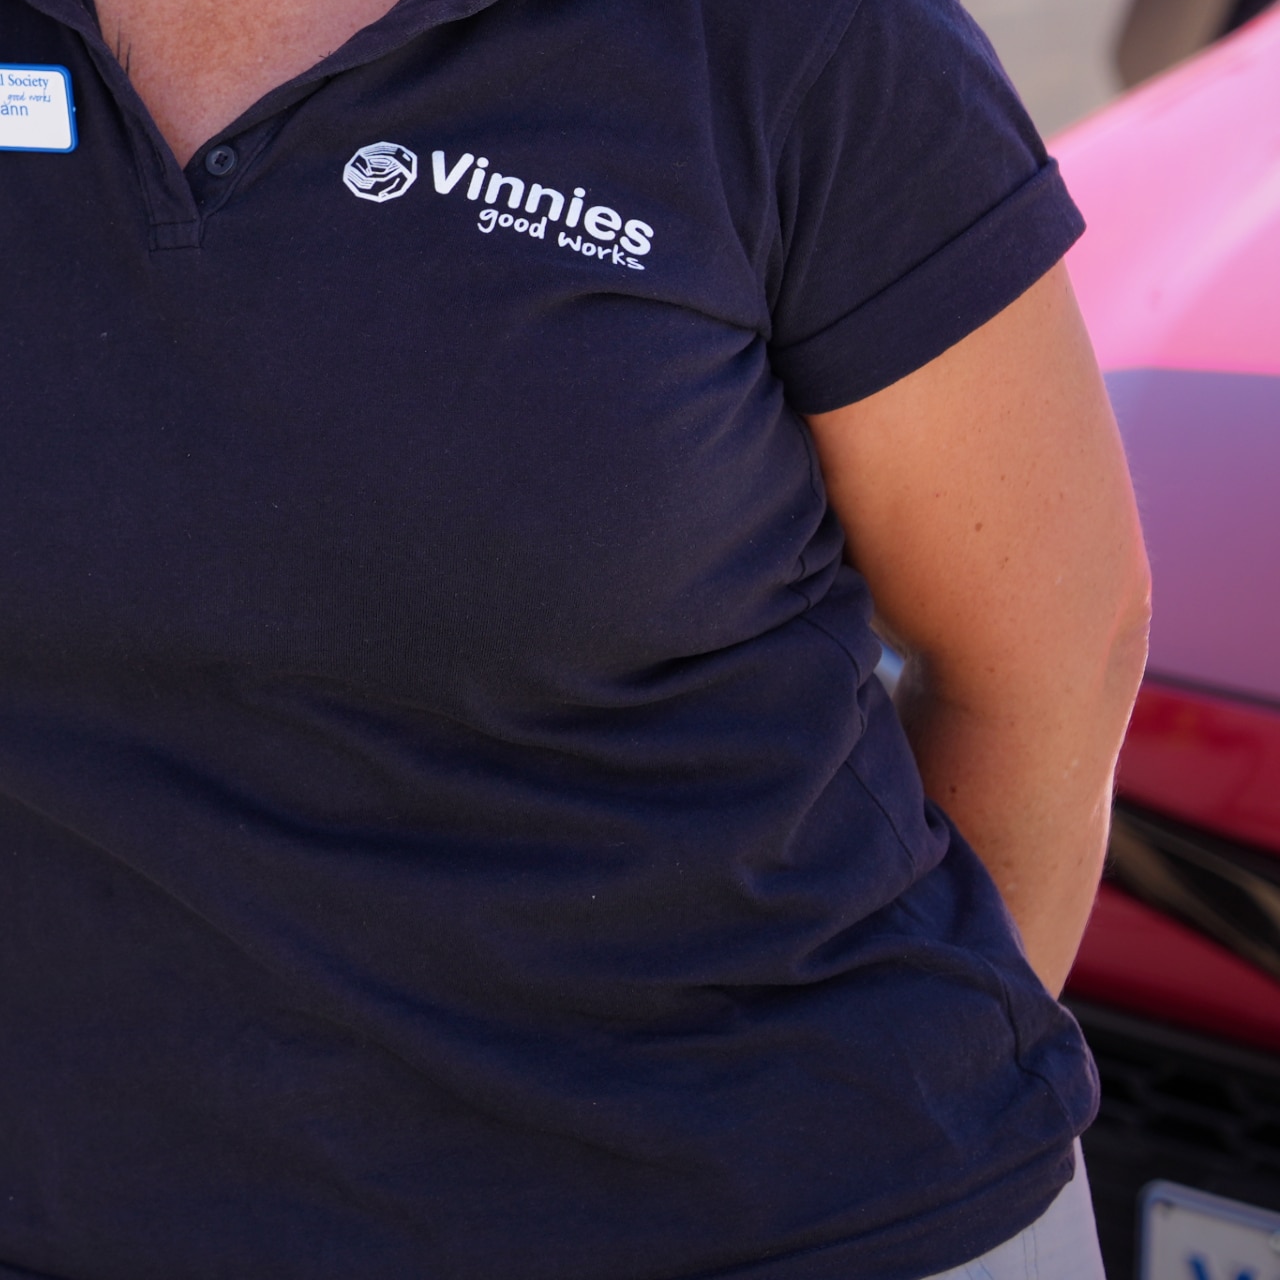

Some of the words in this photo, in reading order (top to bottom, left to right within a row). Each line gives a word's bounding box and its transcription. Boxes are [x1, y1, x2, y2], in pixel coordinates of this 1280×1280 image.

[4, 92, 26, 105] good
[29, 93, 51, 103] works
[8, 74, 49, 90] Society
[431, 150, 654, 255] Vinnies
[477, 208, 548, 239] good
[558, 231, 645, 270] works
